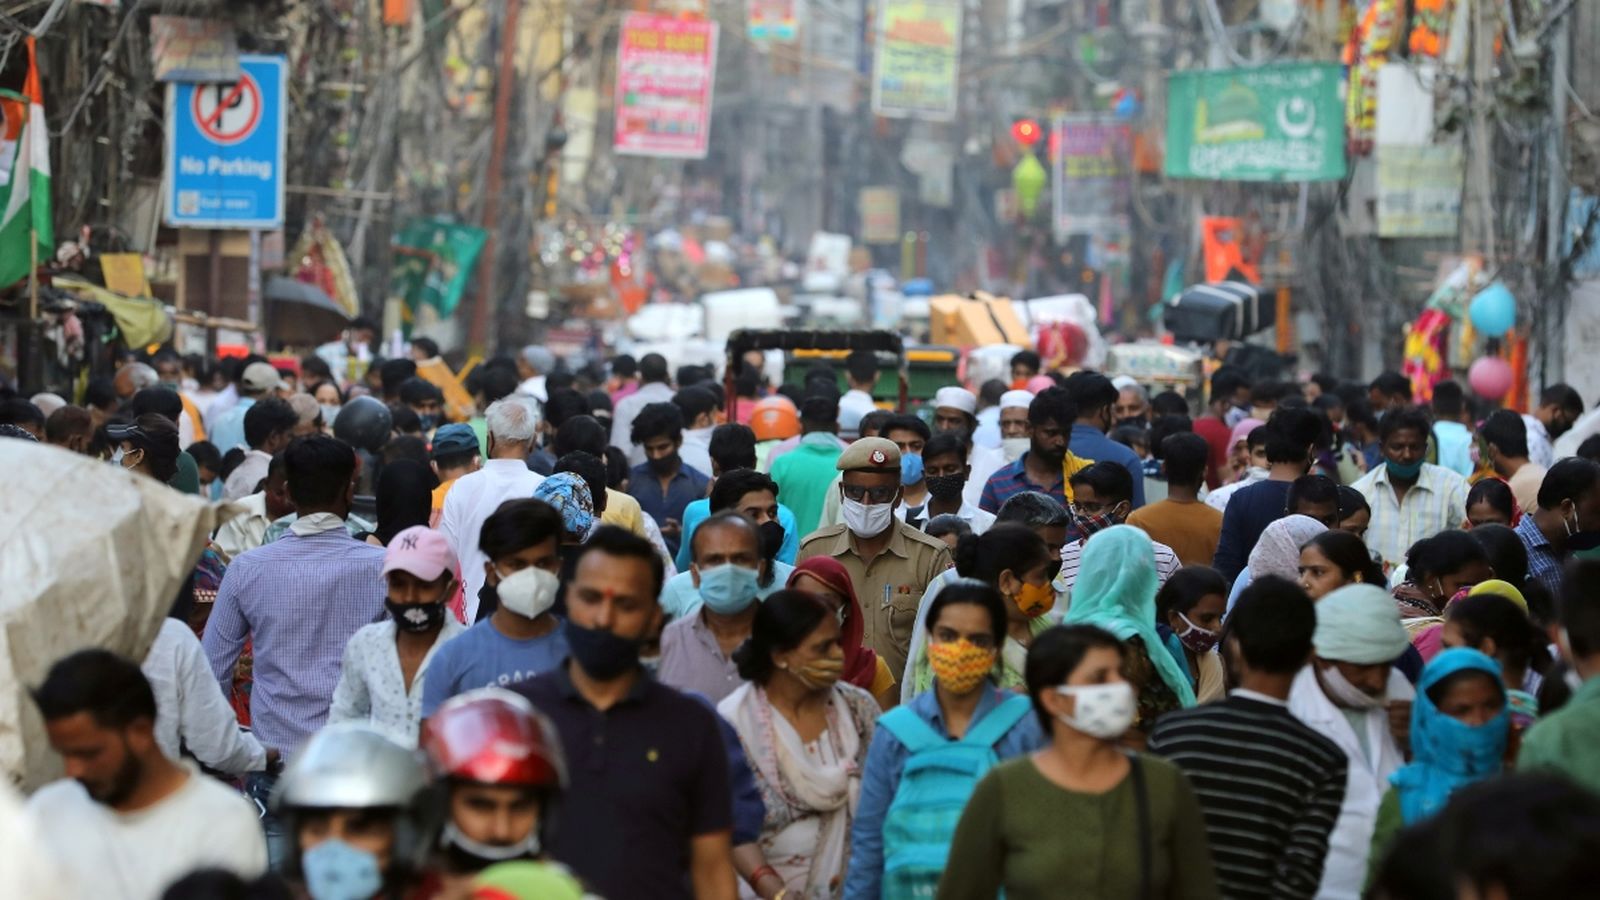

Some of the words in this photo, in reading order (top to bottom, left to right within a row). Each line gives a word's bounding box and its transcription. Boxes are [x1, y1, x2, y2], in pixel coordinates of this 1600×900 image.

[181, 157, 205, 175] No
[207, 156, 272, 181] Parking
[401, 534, 419, 550] NY
